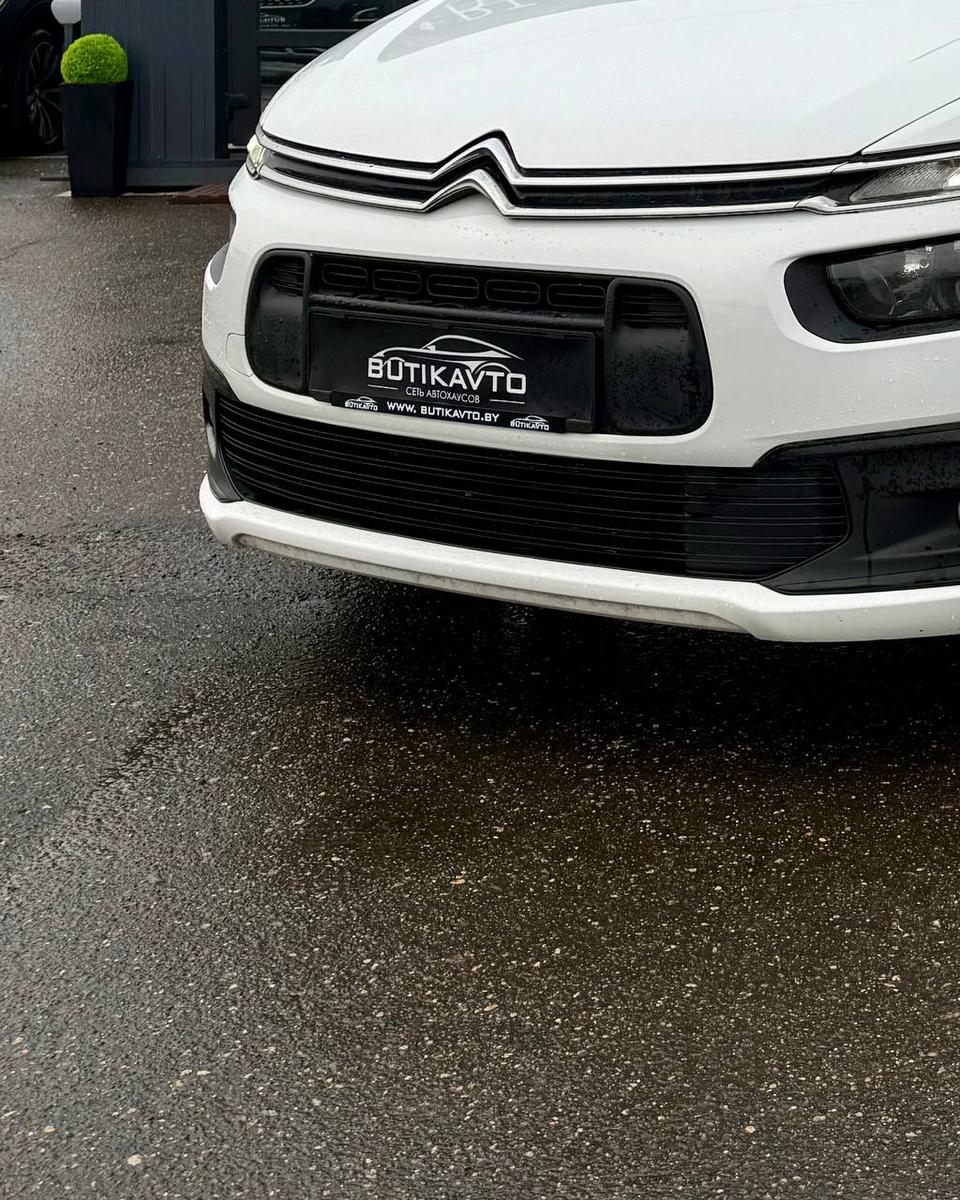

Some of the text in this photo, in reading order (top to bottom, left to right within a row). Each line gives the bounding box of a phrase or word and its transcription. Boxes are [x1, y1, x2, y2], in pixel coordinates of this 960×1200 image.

[367, 357, 527, 395] BUTIKAVTO
[405, 386, 481, 404] СЕТЬ АВТОХАУСОВ
[386, 401, 500, 423] WWW. BUTIKAVTO.BY
